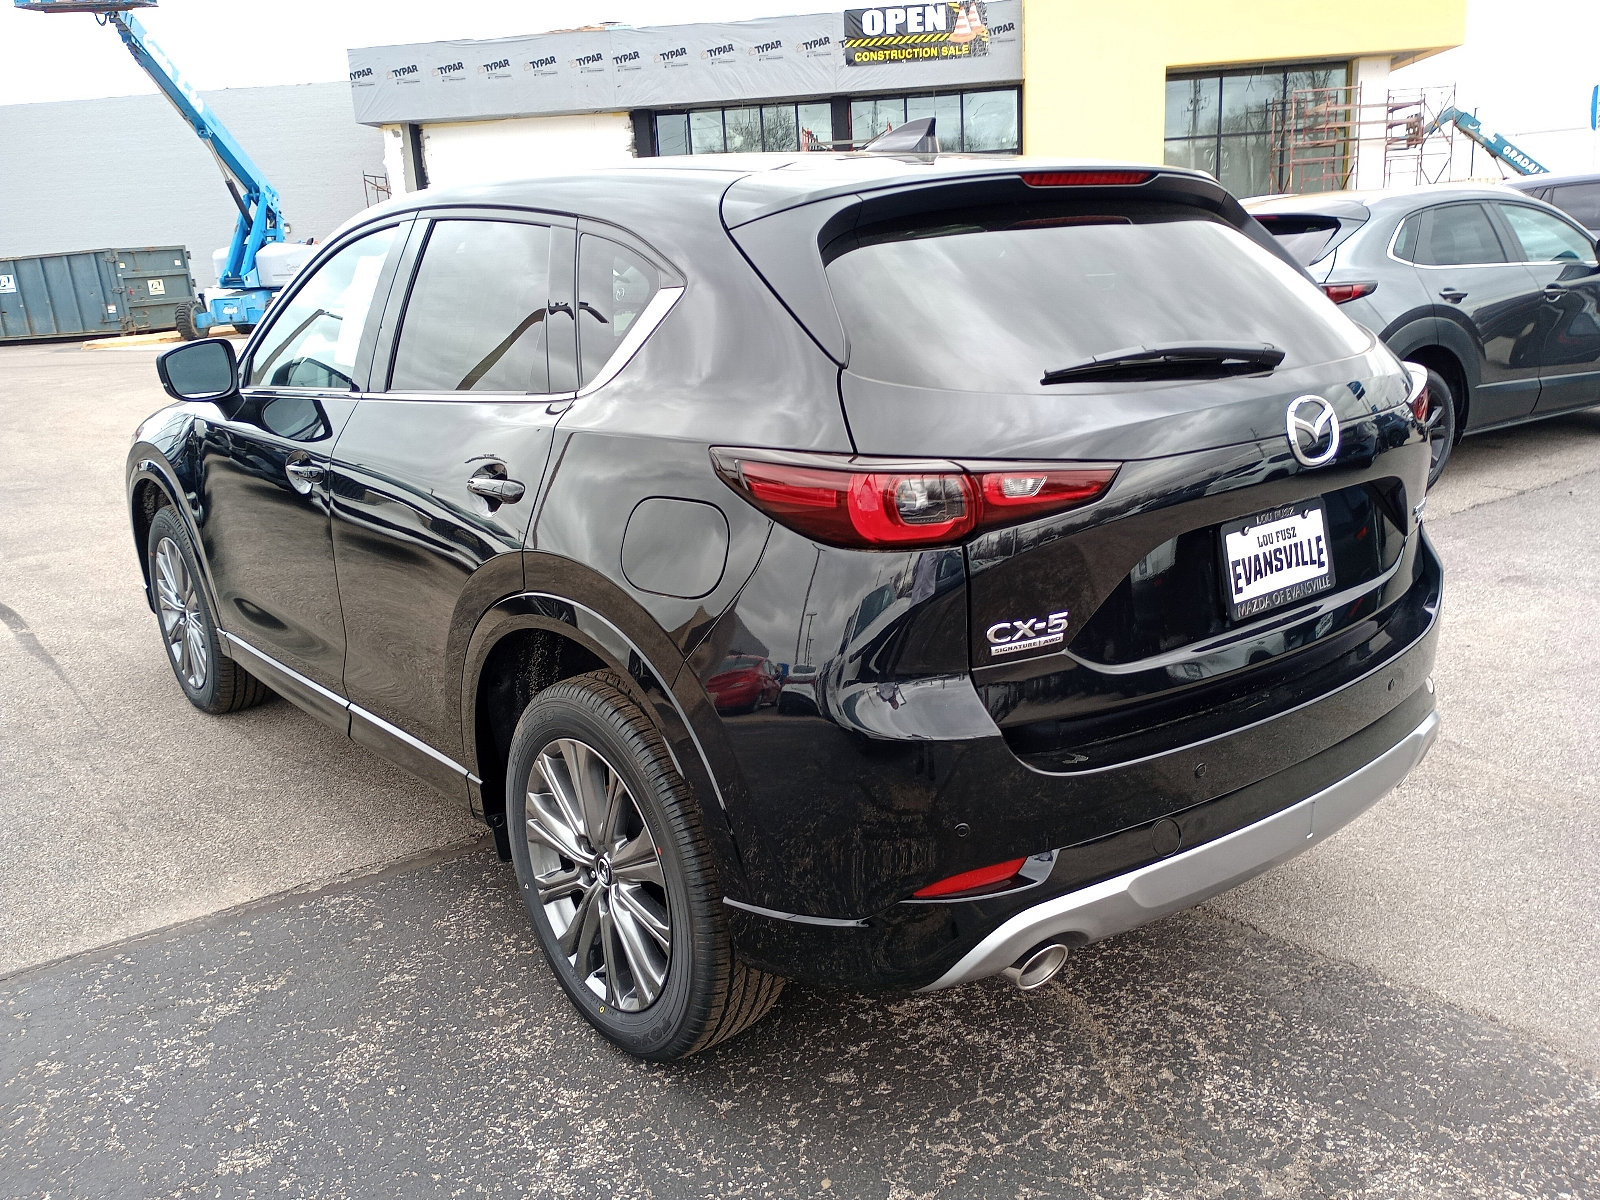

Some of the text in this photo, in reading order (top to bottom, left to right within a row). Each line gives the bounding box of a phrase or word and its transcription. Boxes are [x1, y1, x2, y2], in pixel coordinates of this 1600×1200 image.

[861, 4, 947, 36] OPEN
[707, 43, 734, 57] TYPAR
[754, 40, 782, 54] TYPAR
[803, 36, 830, 50] TYPAR
[576, 52, 604, 66] TYPAR
[613, 51, 640, 65] TYPAR
[660, 47, 687, 61] TYPAR
[854, 44, 970, 62] CONSTRUCTION SALE
[438, 61, 464, 75] TYPAR
[483, 58, 510, 72] TYPAR
[529, 55, 557, 69] TYPAR
[392, 64, 419, 78] TYPAR
[1257, 526, 1297, 547] LOU FUSZ
[1231, 535, 1326, 595] EVANSVILLE
[1237, 575, 1331, 618] MAZDA OF EVANSVILLE
[986, 610, 1069, 644] CX-5
[994, 636, 1061, 654] SIGNATURE AWD
